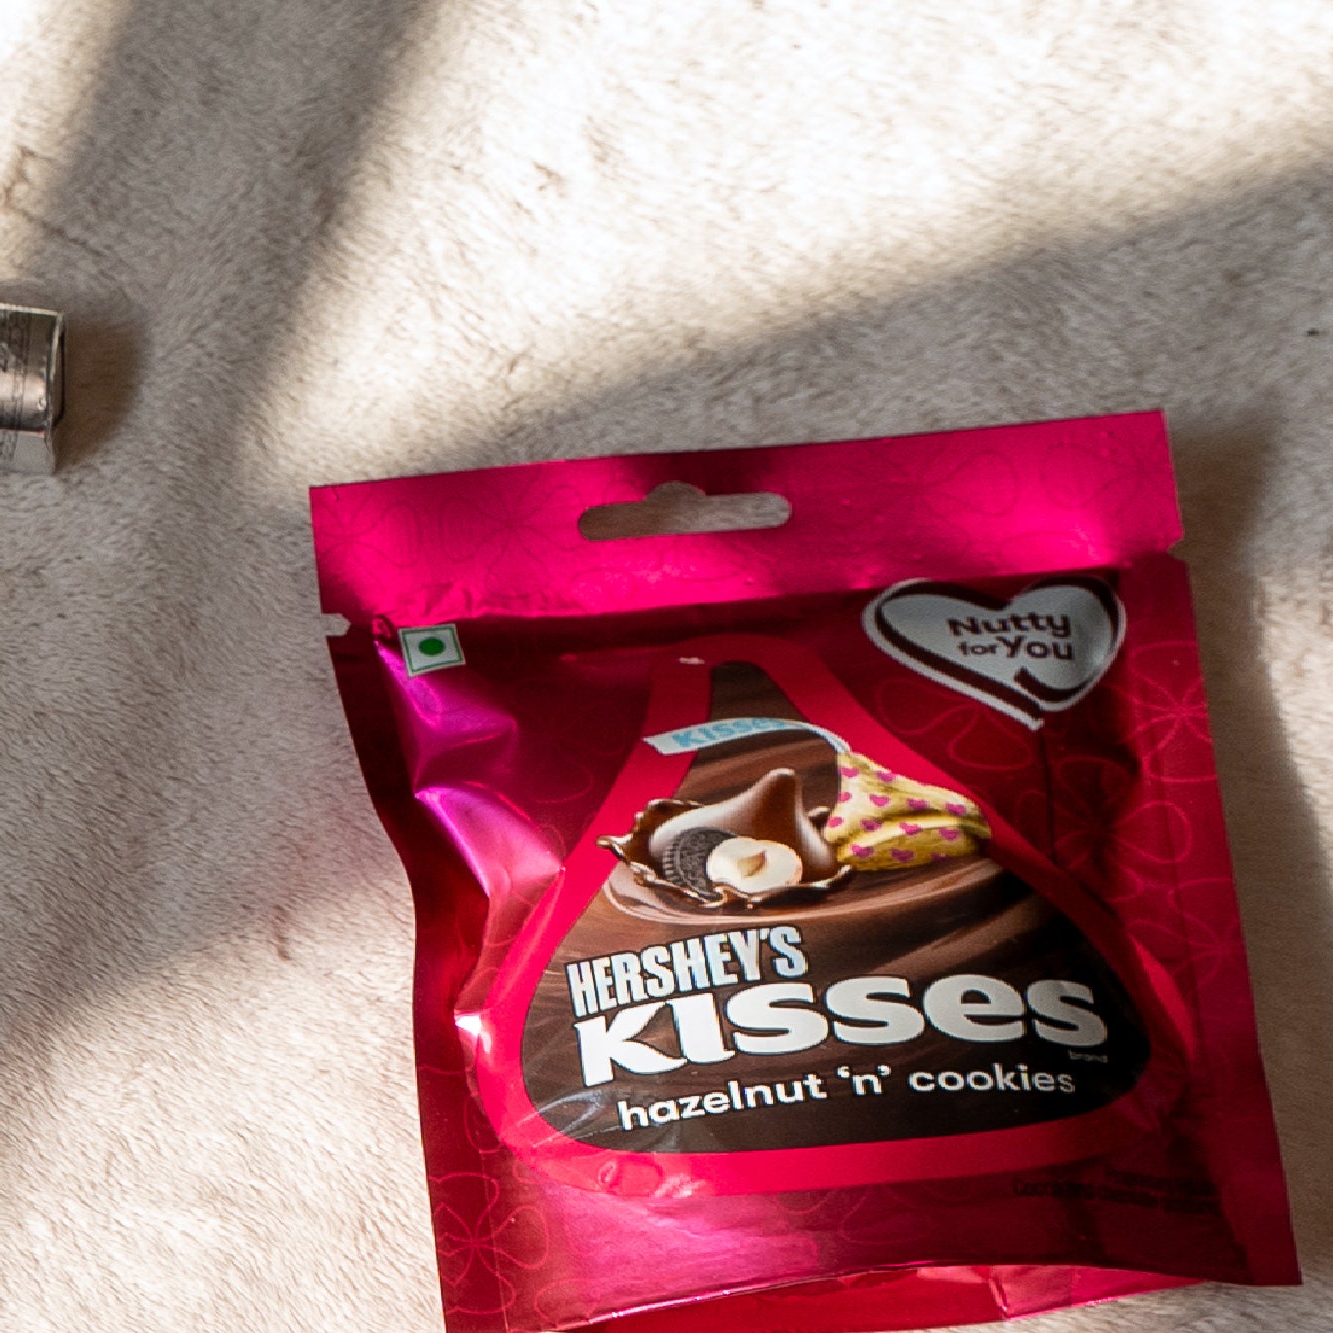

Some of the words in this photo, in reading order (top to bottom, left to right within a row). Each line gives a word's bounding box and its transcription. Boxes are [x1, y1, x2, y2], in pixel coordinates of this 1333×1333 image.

[946, 611, 1072, 637] Nutty
[958, 642, 997, 656] for
[565, 924, 809, 1018] HERSHEY'S
[617, 1073, 827, 1131] hazelnut
[909, 1062, 1076, 1094] cookies
